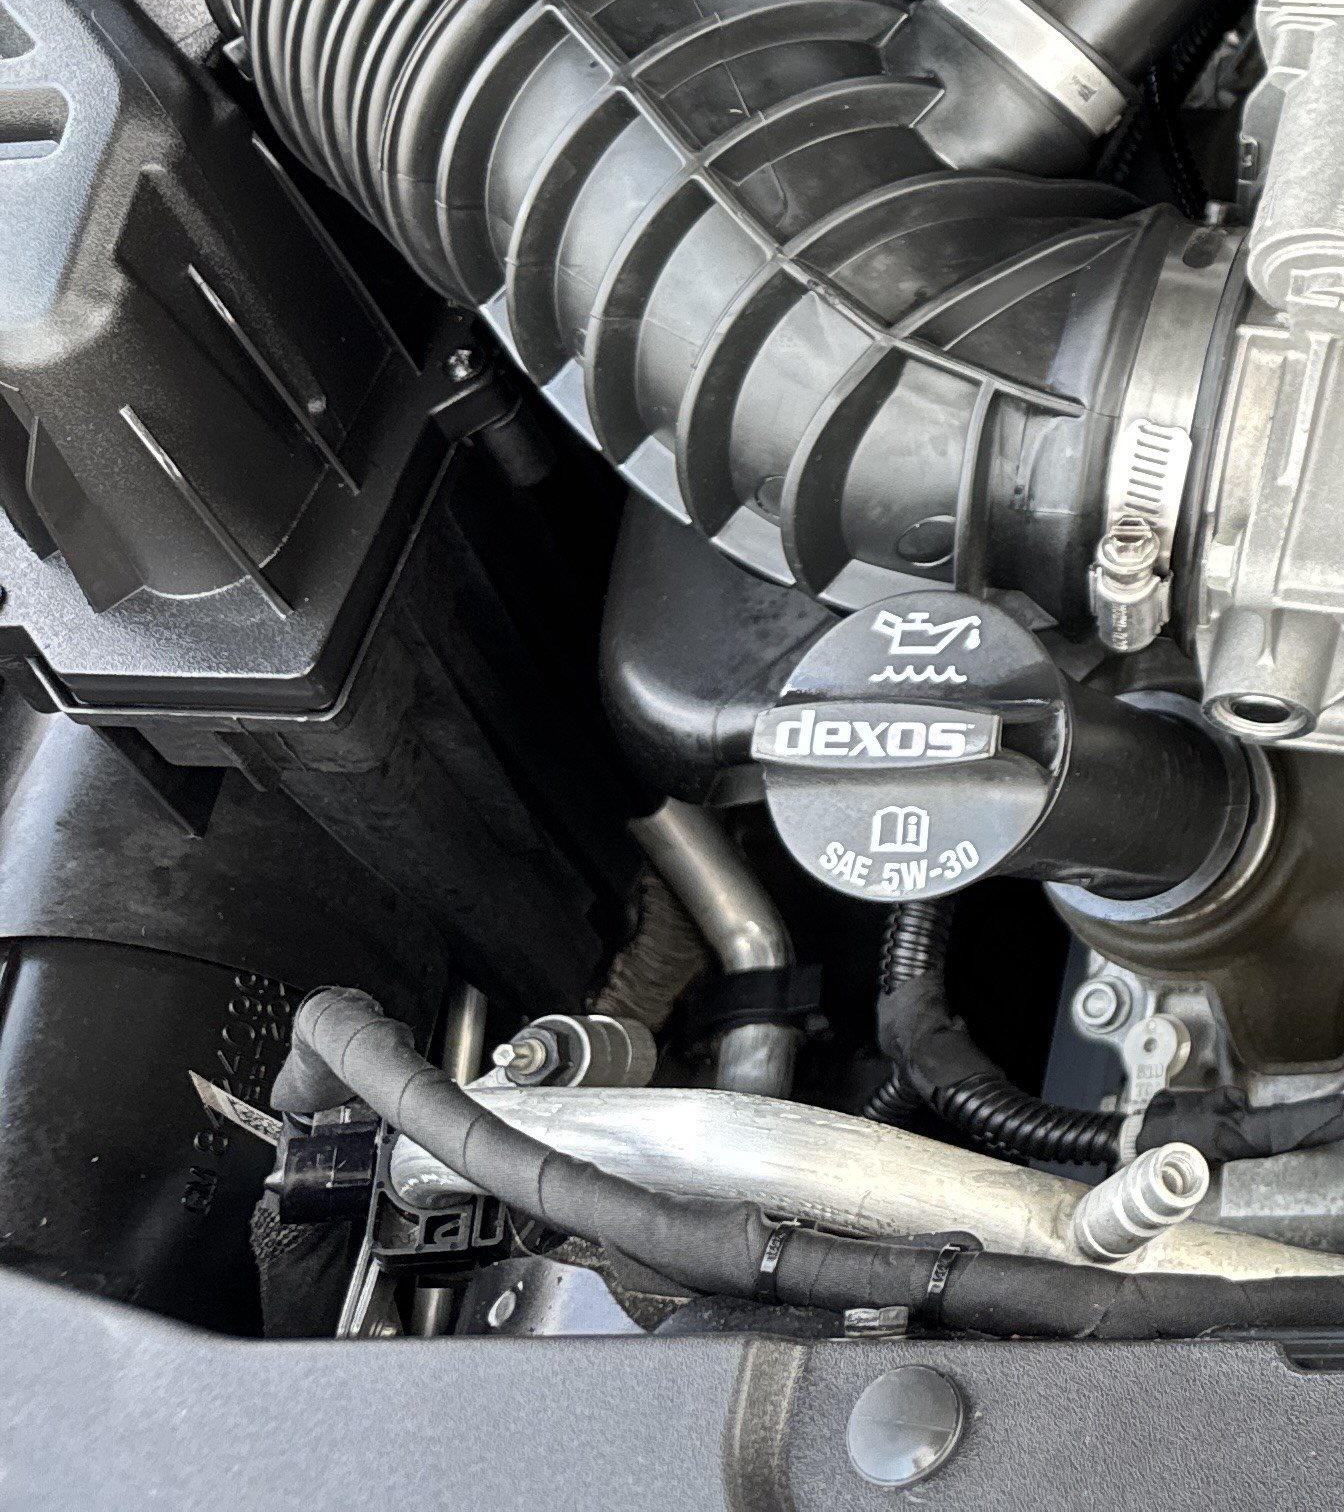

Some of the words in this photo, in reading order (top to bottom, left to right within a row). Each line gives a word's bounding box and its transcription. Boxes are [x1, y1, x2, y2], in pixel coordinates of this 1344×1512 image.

[774, 709, 968, 758] dexos
[818, 841, 873, 886] SAE
[881, 840, 980, 891] 5W-30
